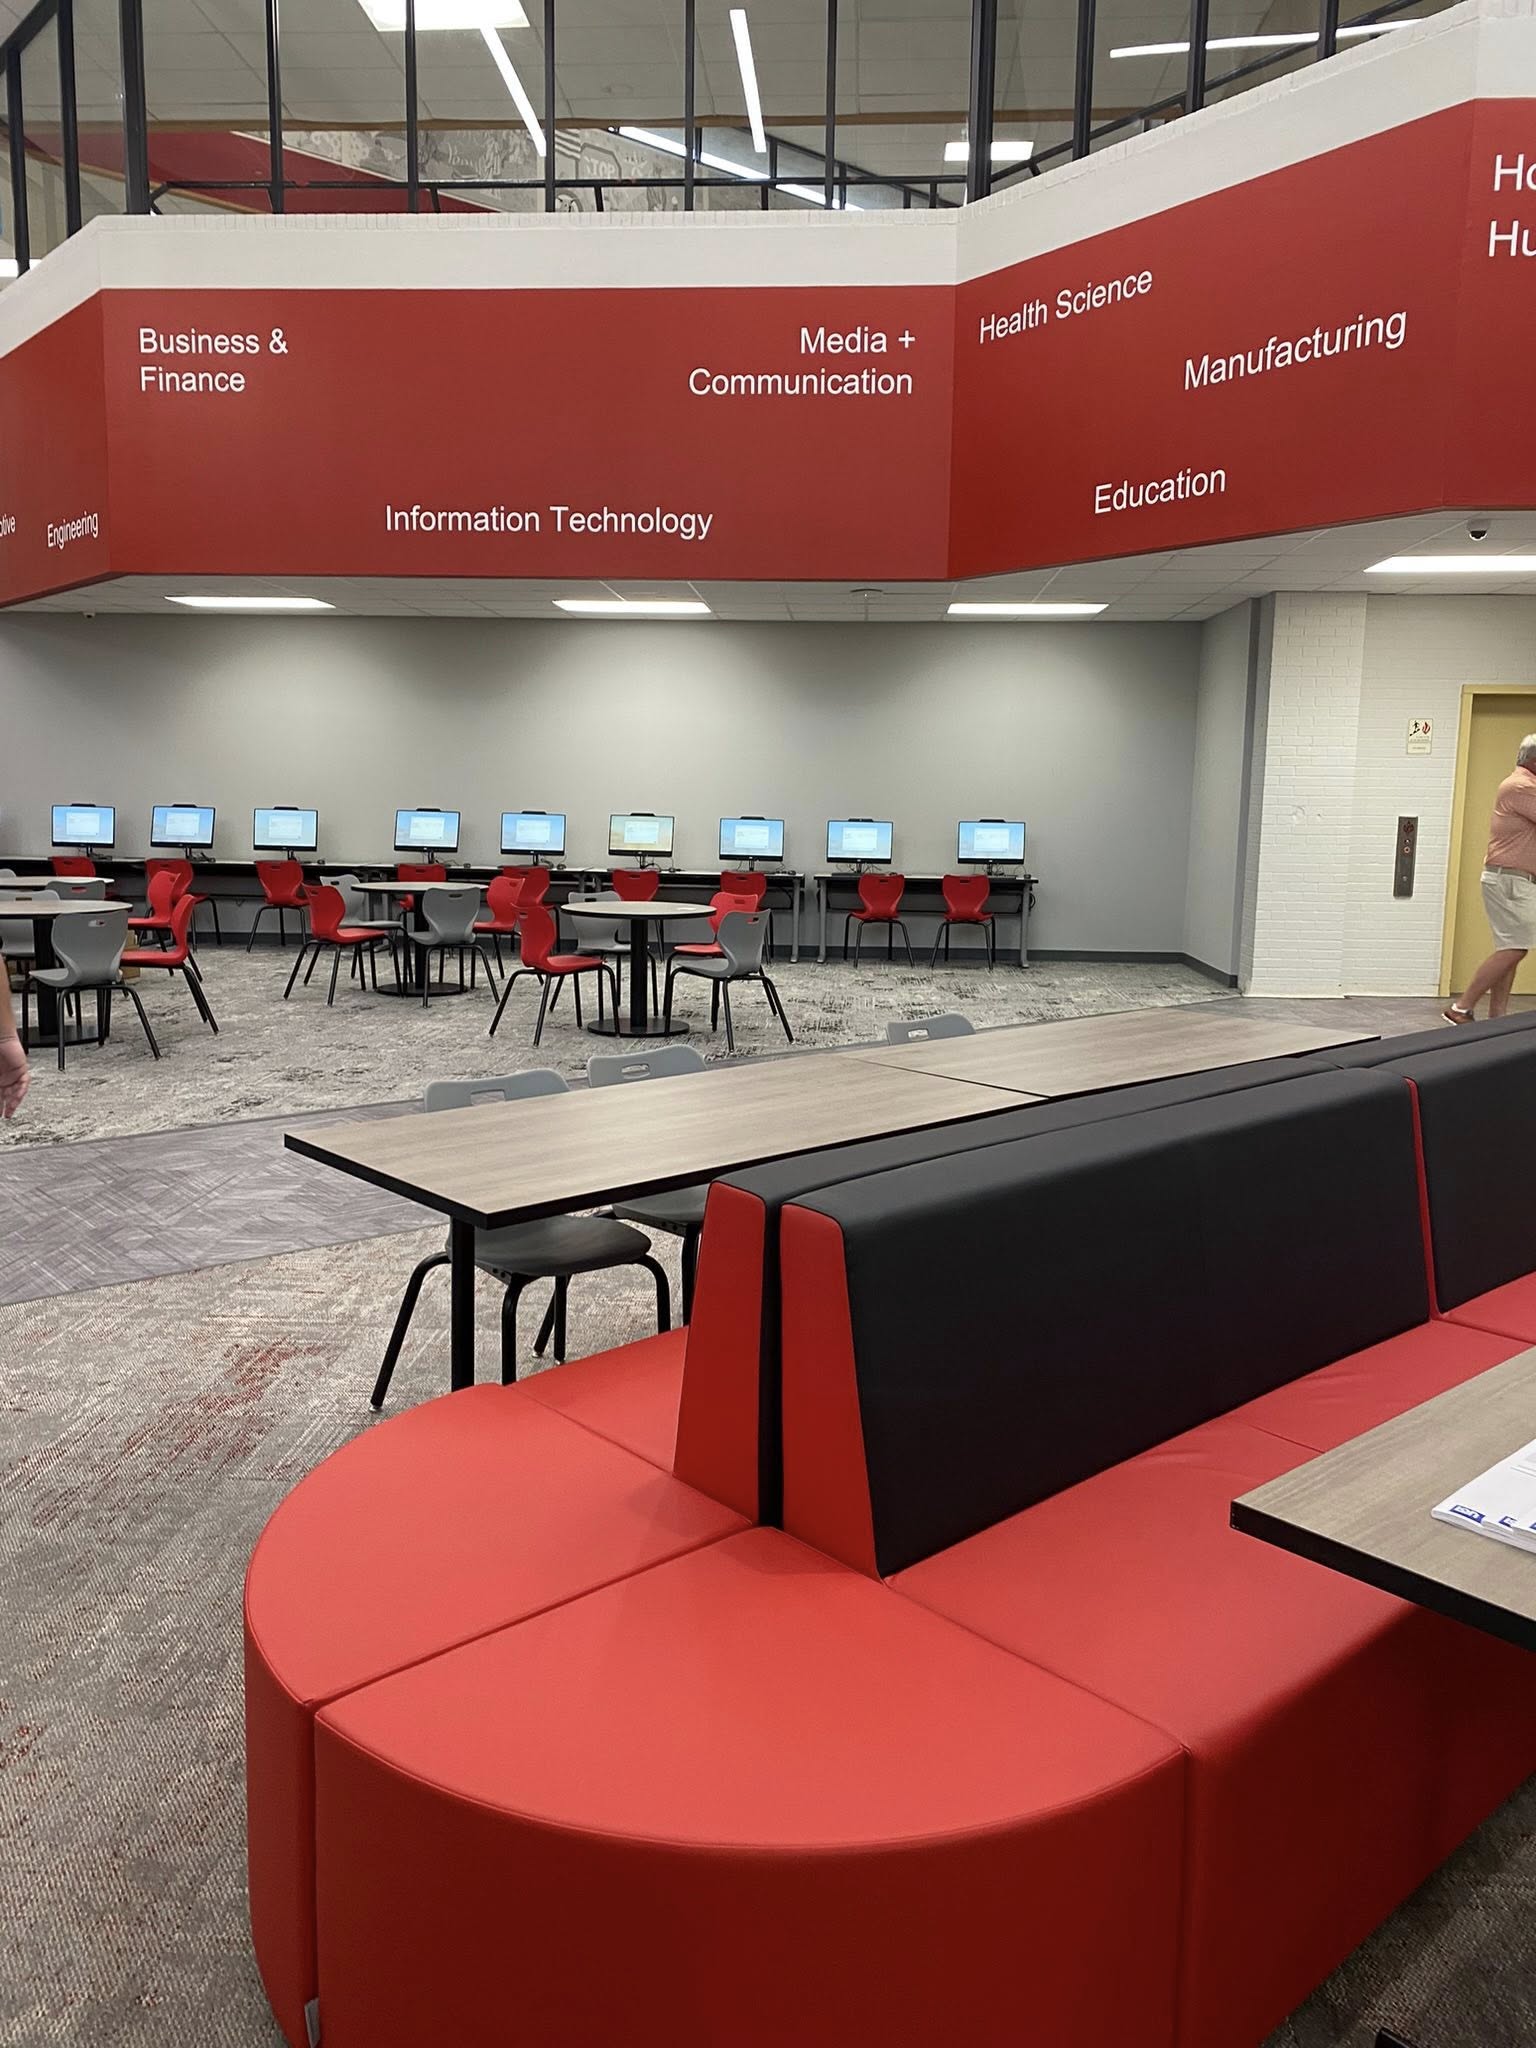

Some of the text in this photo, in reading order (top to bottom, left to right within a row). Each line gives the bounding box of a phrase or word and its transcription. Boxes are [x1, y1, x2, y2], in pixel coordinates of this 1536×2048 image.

[1488, 220, 1536, 258] Hu
[979, 270, 1154, 345] Health Science
[139, 327, 289, 355] Business &
[800, 326, 916, 354] Media +
[1184, 311, 1407, 392] Manufacturing
[140, 366, 246, 393] Finance
[689, 367, 914, 396] Communication
[1094, 467, 1227, 514] Education
[47, 510, 99, 550] Engineering
[386, 504, 713, 541] Information Technology
